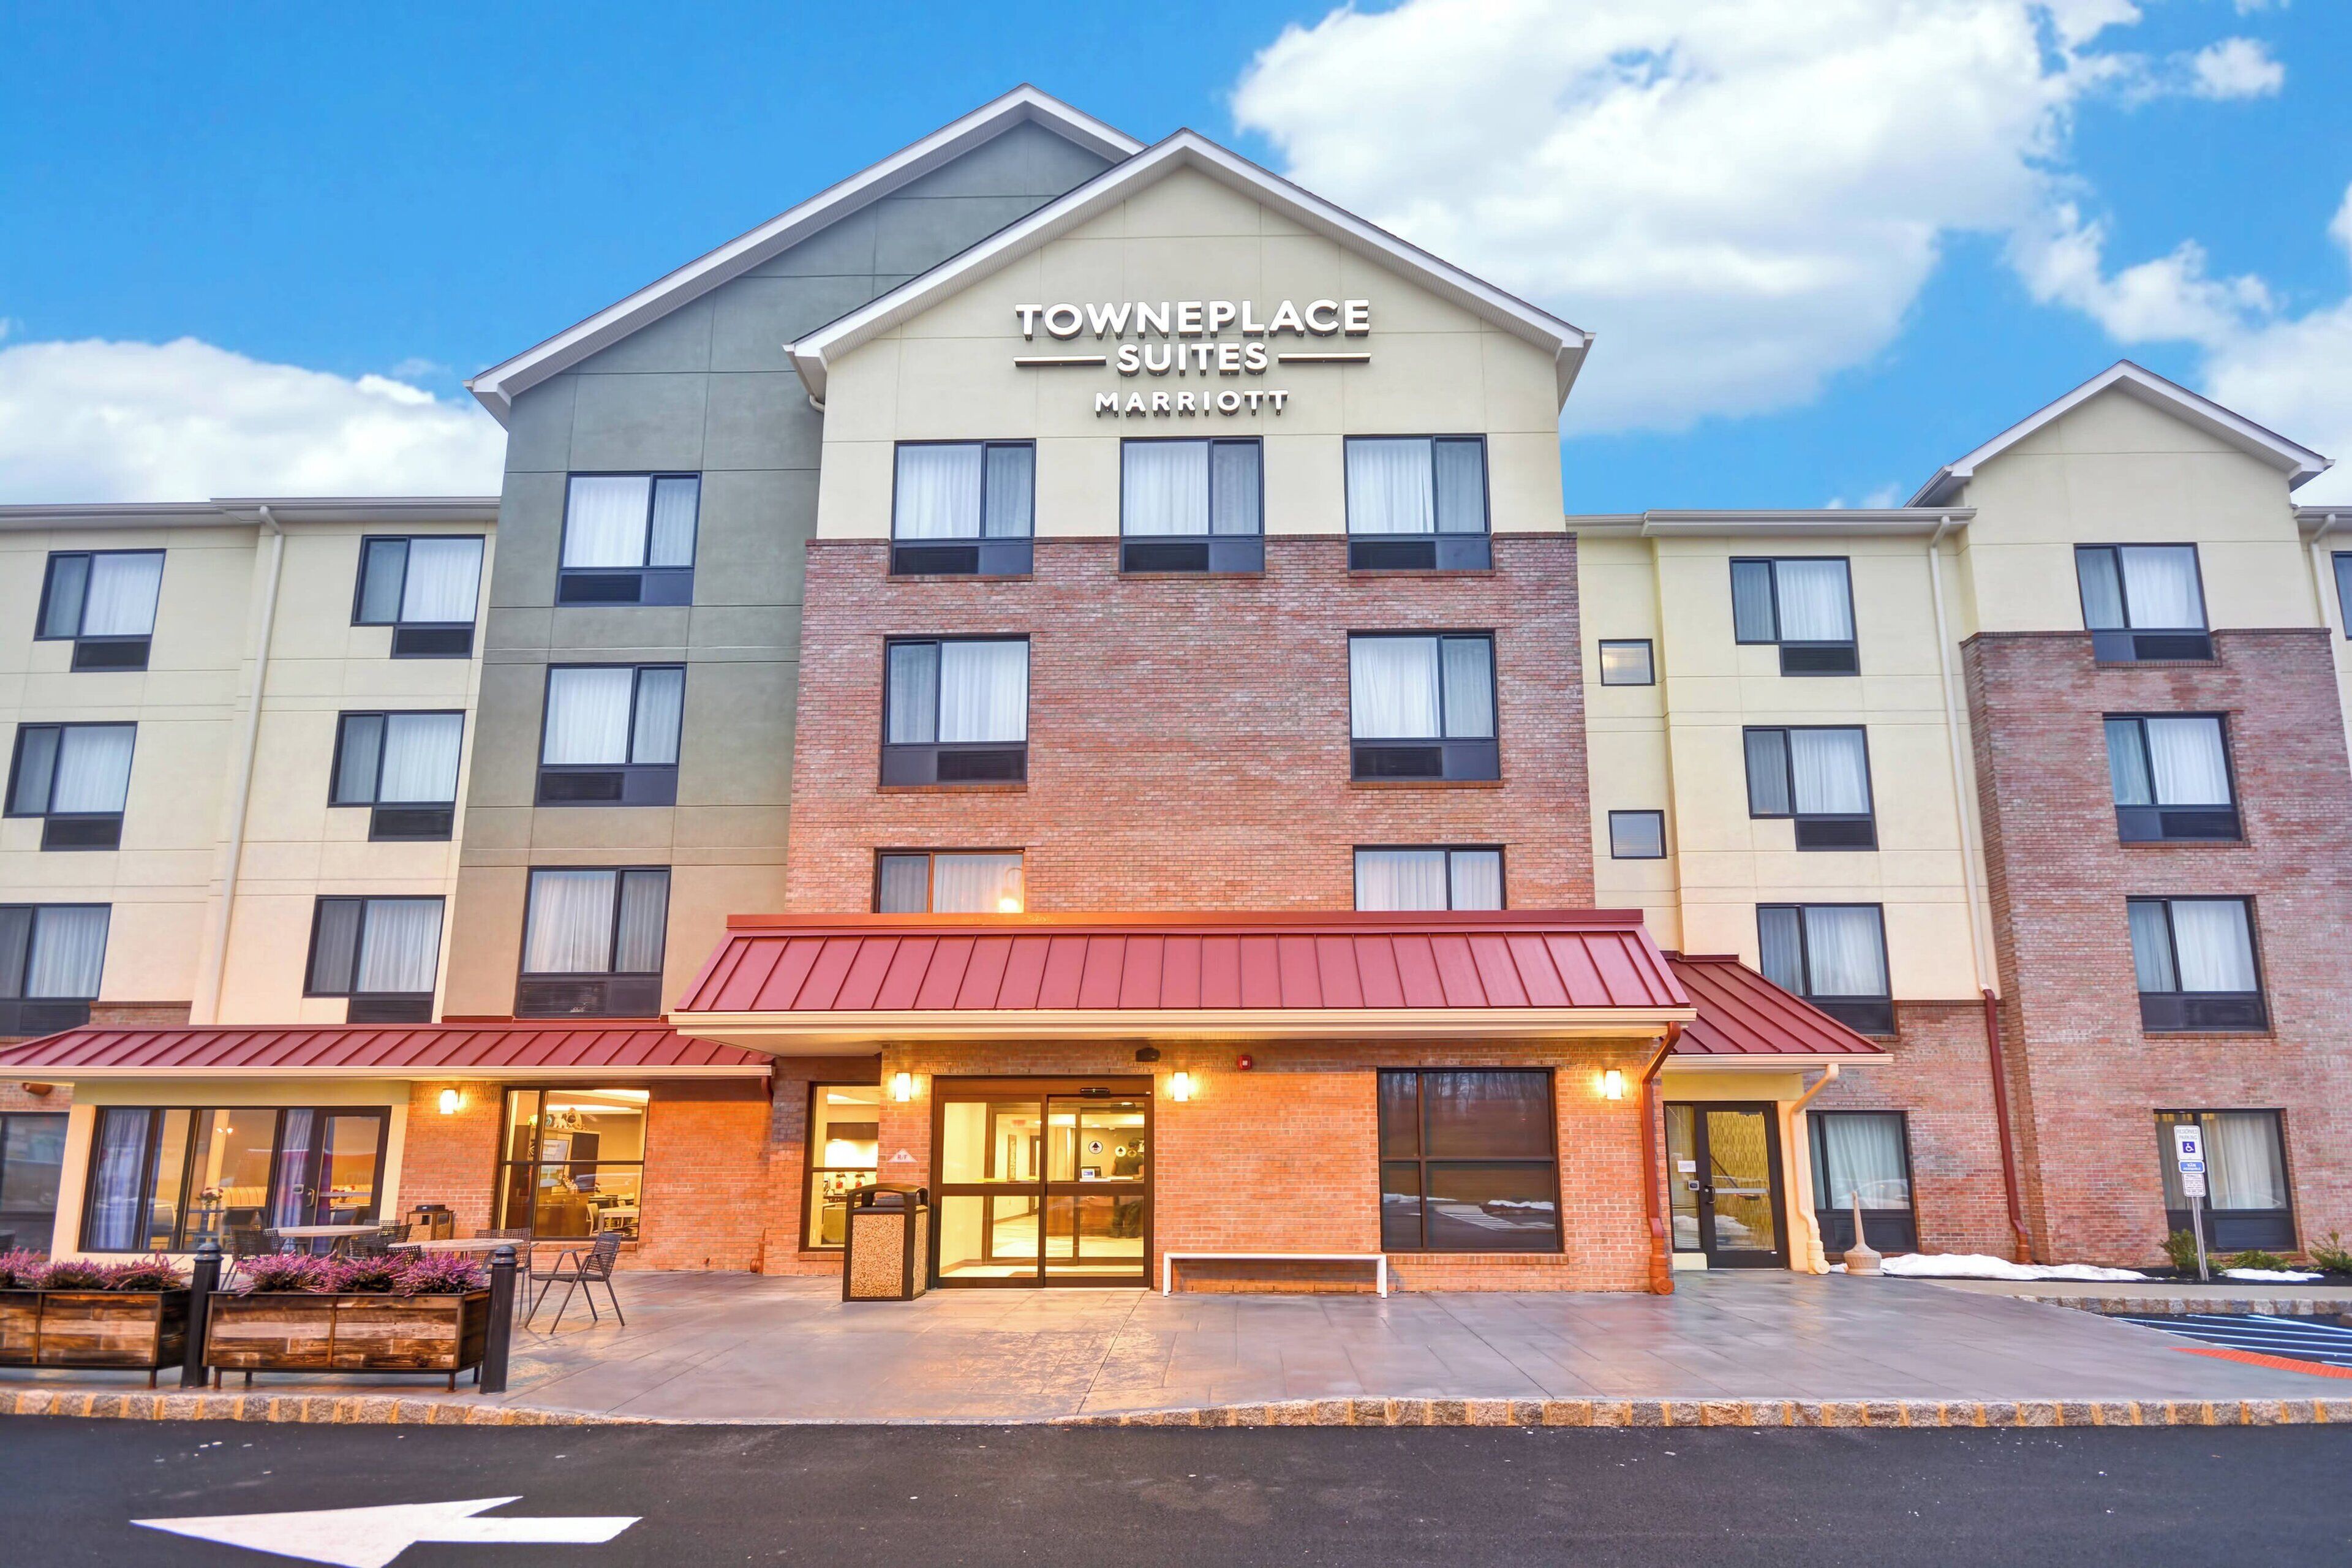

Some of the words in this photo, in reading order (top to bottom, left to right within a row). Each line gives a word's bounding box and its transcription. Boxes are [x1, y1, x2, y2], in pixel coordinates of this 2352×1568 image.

[1015, 298, 1370, 340] TOWNEPLACE
[1117, 342, 1268, 377] SUITES
[1095, 390, 1289, 417] MARRIOTT
